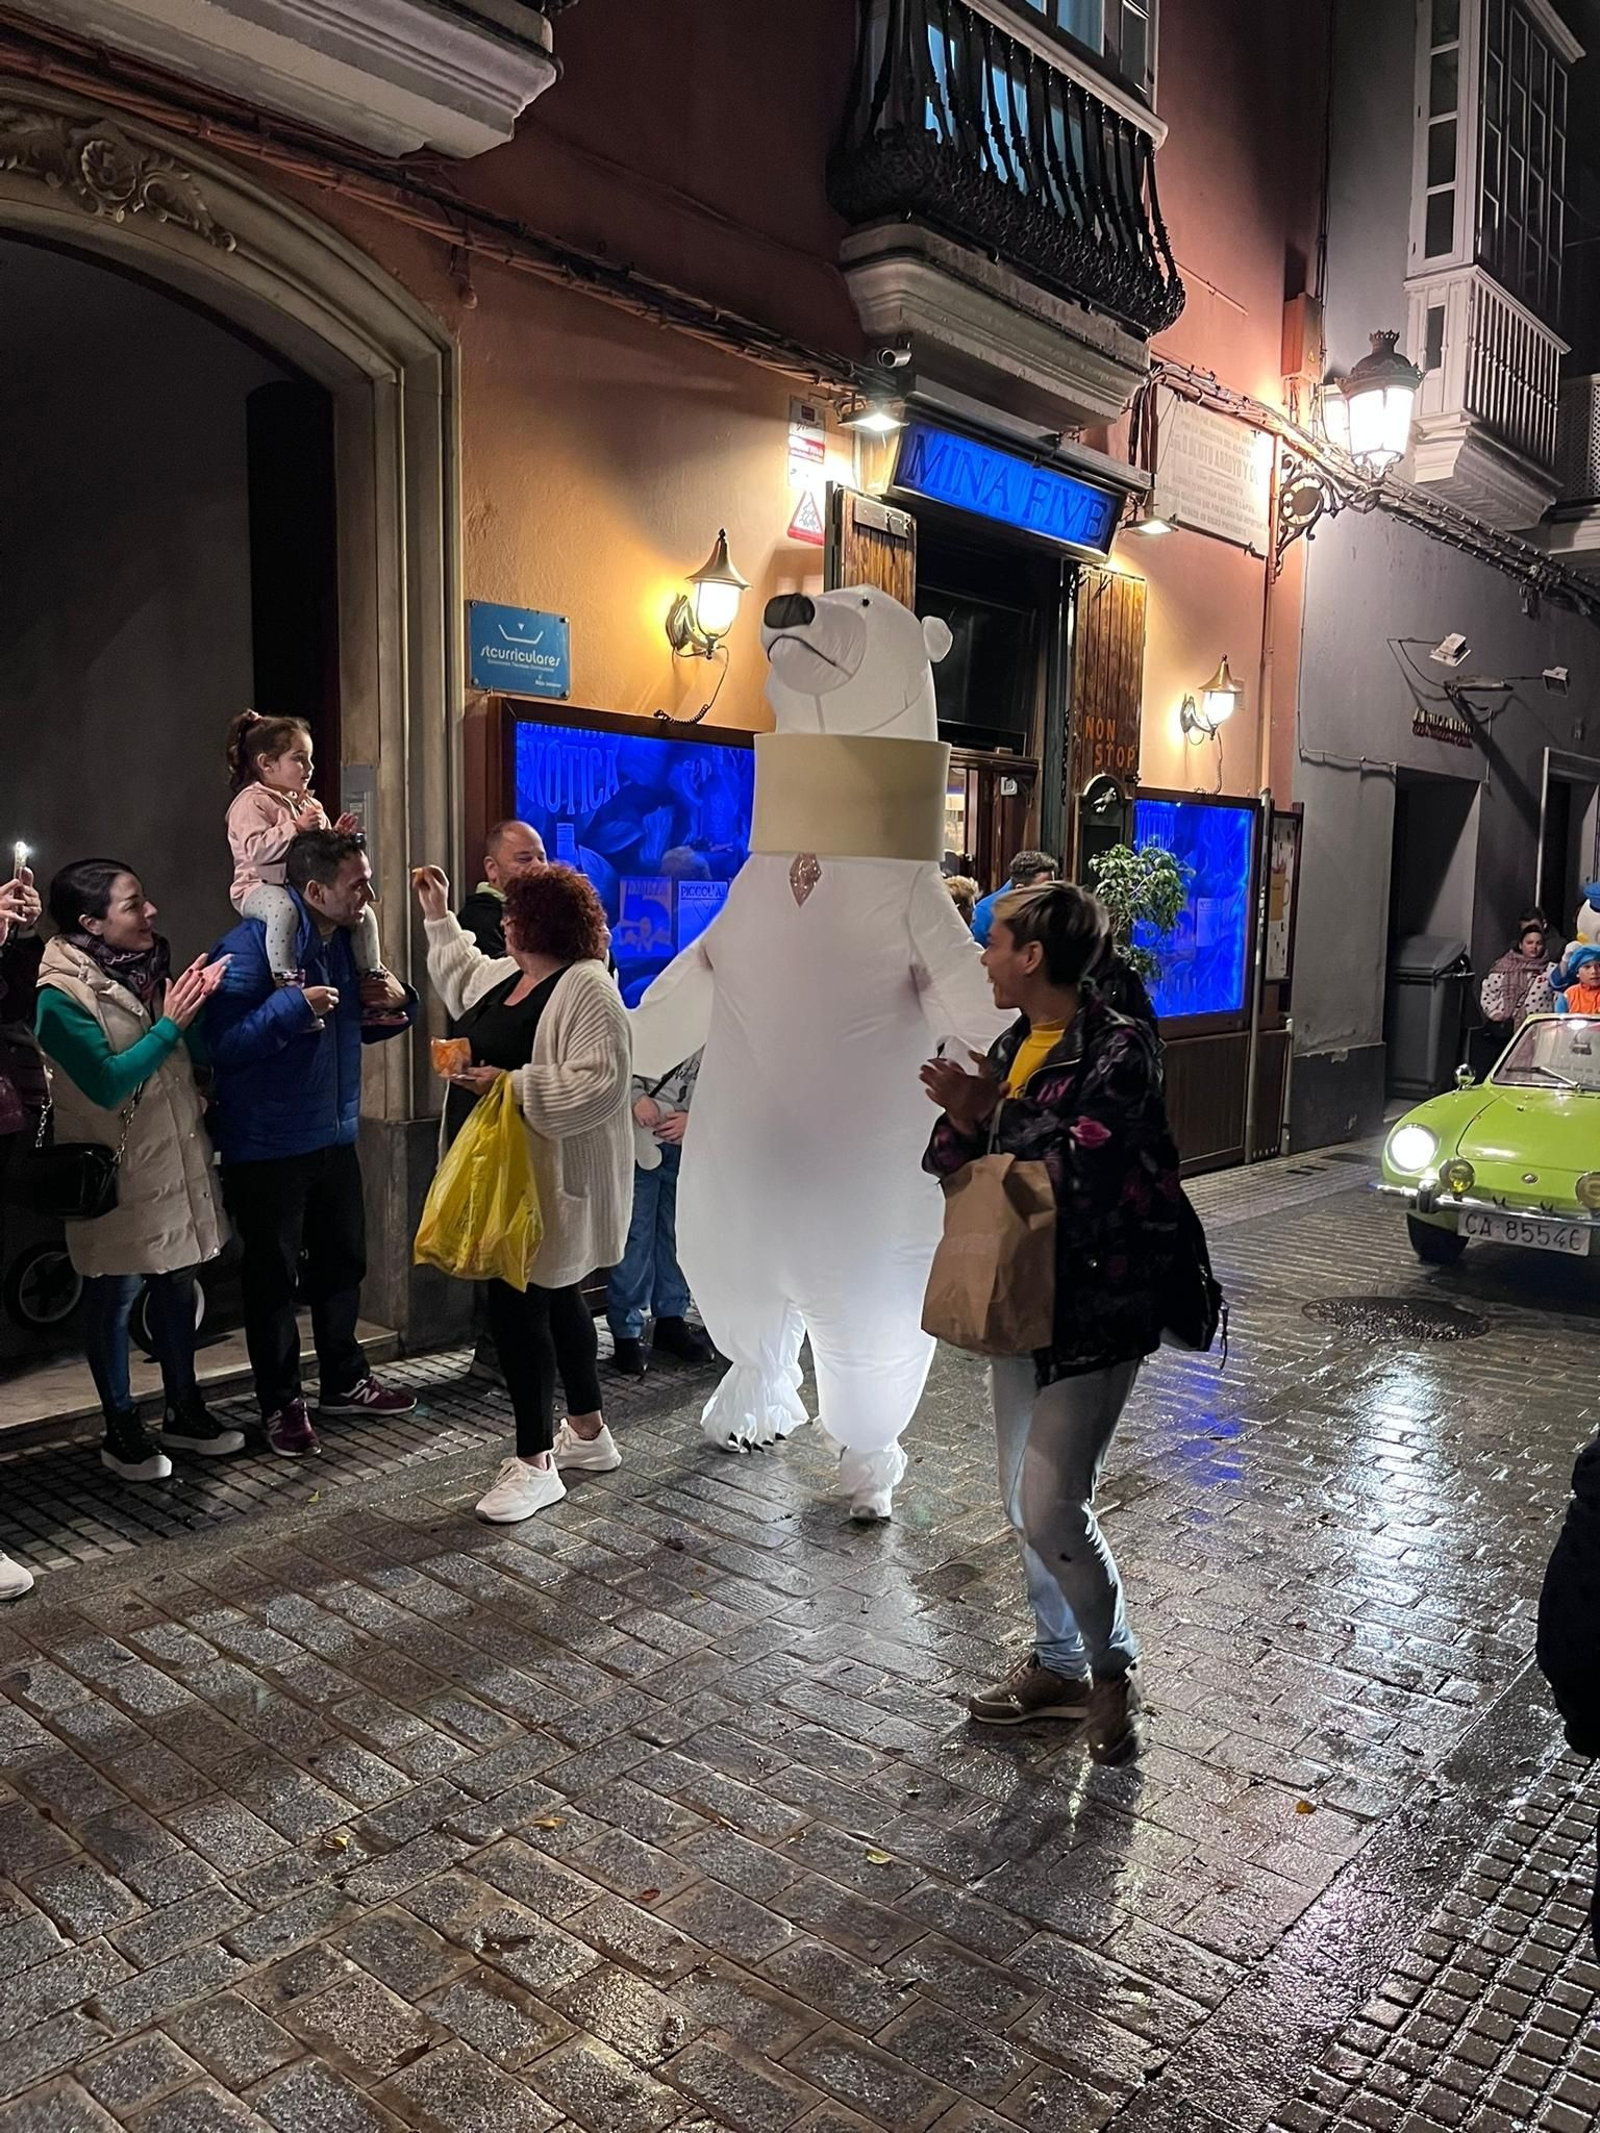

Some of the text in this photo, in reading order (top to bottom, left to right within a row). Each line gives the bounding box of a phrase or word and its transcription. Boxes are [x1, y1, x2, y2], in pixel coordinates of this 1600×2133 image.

[906, 434, 1010, 514] MINA
[1022, 477, 1108, 542] FIVE
[1085, 716, 1116, 741] NON
[1095, 743, 1136, 768] STOP
